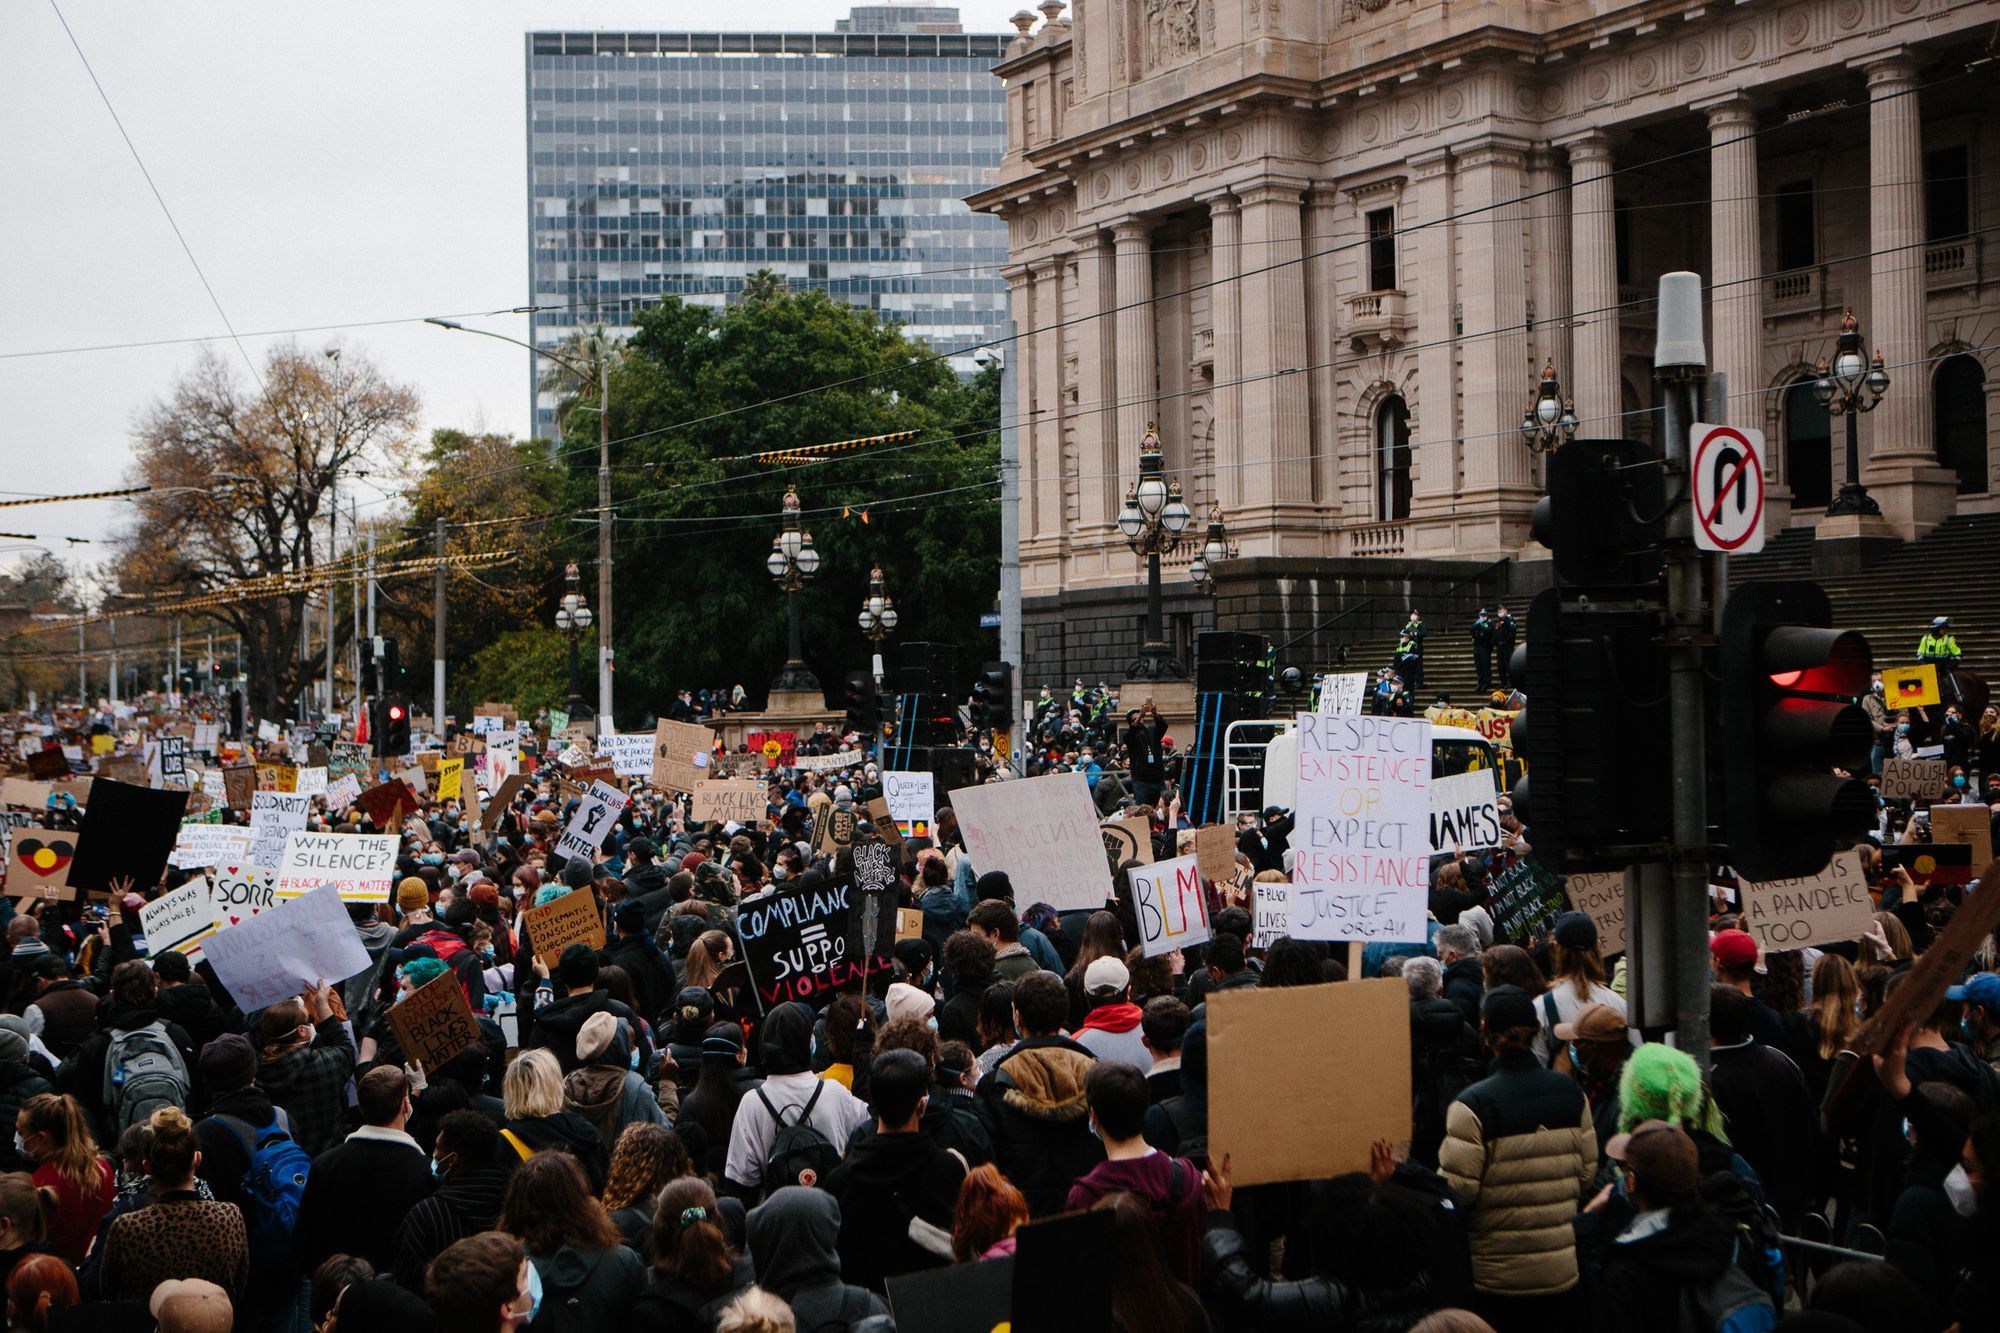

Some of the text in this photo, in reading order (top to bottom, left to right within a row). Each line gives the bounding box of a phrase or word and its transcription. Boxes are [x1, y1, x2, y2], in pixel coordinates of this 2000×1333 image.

[600, 736, 614, 748] WHO
[616, 736, 626, 746] DO
[1302, 714, 1430, 753] RESPECT
[444, 763, 460, 776] STOP
[1300, 752, 1427, 788] EXISTENCE
[1884, 760, 1947, 781] ABOLISH
[589, 786, 624, 810] BLACK LIVES
[702, 791, 767, 809] BLACK LIVES
[1340, 787, 1382, 816] OR
[1884, 779, 1940, 796] POLICE!
[253, 794, 310, 815] SOLIDARITY
[710, 806, 757, 821] MATTER
[834, 811, 843, 841] BOX
[1311, 816, 1408, 852] EXPECT
[222, 850, 240, 860] YOU
[295, 837, 389, 851] WHY THE
[853, 843, 892, 867] BLACK
[293, 852, 391, 871] SILENCE?
[858, 859, 884, 874] LIVES
[1296, 849, 1431, 887] RESISTANCE
[1831, 858, 1848, 878] IS
[217, 879, 280, 909] SORR
[325, 879, 355, 892] LVES
[359, 880, 392, 891] MATTER
[1578, 884, 1625, 912] POWE
[145, 889, 198, 924] ALWAYS WAS
[185, 904, 197, 917] BE
[736, 884, 850, 940] COMPLIANC
[1136, 865, 1207, 942] BLM
[1300, 889, 1398, 928] JUSTICE
[1752, 900, 1766, 919] A
[530, 904, 588, 935] SYSTEMATIC
[533, 914, 587, 944] CONSCIOUS
[1258, 911, 1288, 928] LIVES
[1596, 907, 1626, 930] TRU
[1754, 919, 1812, 946] TOO
[536, 922, 599, 955] SUBCONSCIOUS
[772, 936, 845, 980] SUPPO
[811, 956, 843, 973] OF
[759, 954, 894, 1003] VIOLENCE
[402, 984, 458, 1029] RACISM
[404, 980, 440, 1013] STOP
[409, 1002, 458, 1043] BLACK
[423, 1016, 468, 1053] LIVES
[421, 1030, 477, 1072] MATTER
